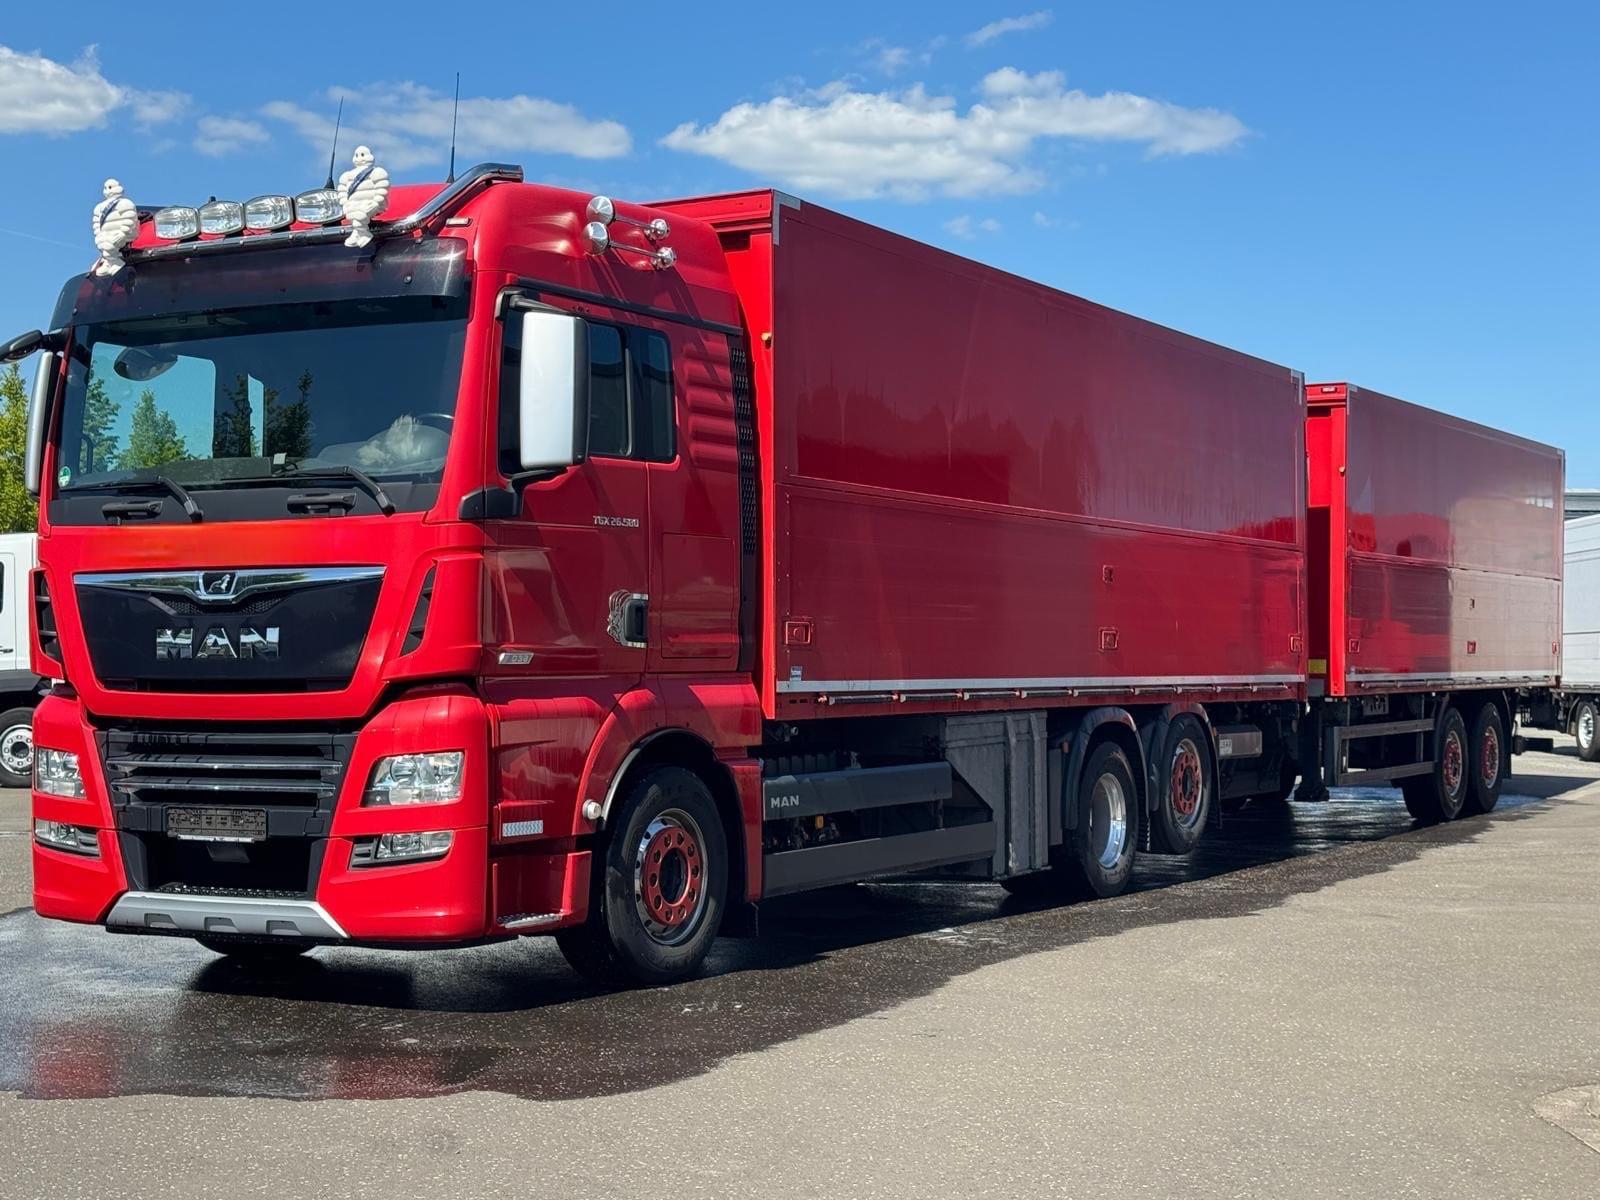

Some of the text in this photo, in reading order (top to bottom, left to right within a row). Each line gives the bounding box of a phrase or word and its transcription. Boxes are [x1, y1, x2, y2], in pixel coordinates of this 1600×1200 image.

[592, 515, 610, 526] TGX
[156, 627, 280, 659] MAN
[770, 795, 800, 809] MAN
